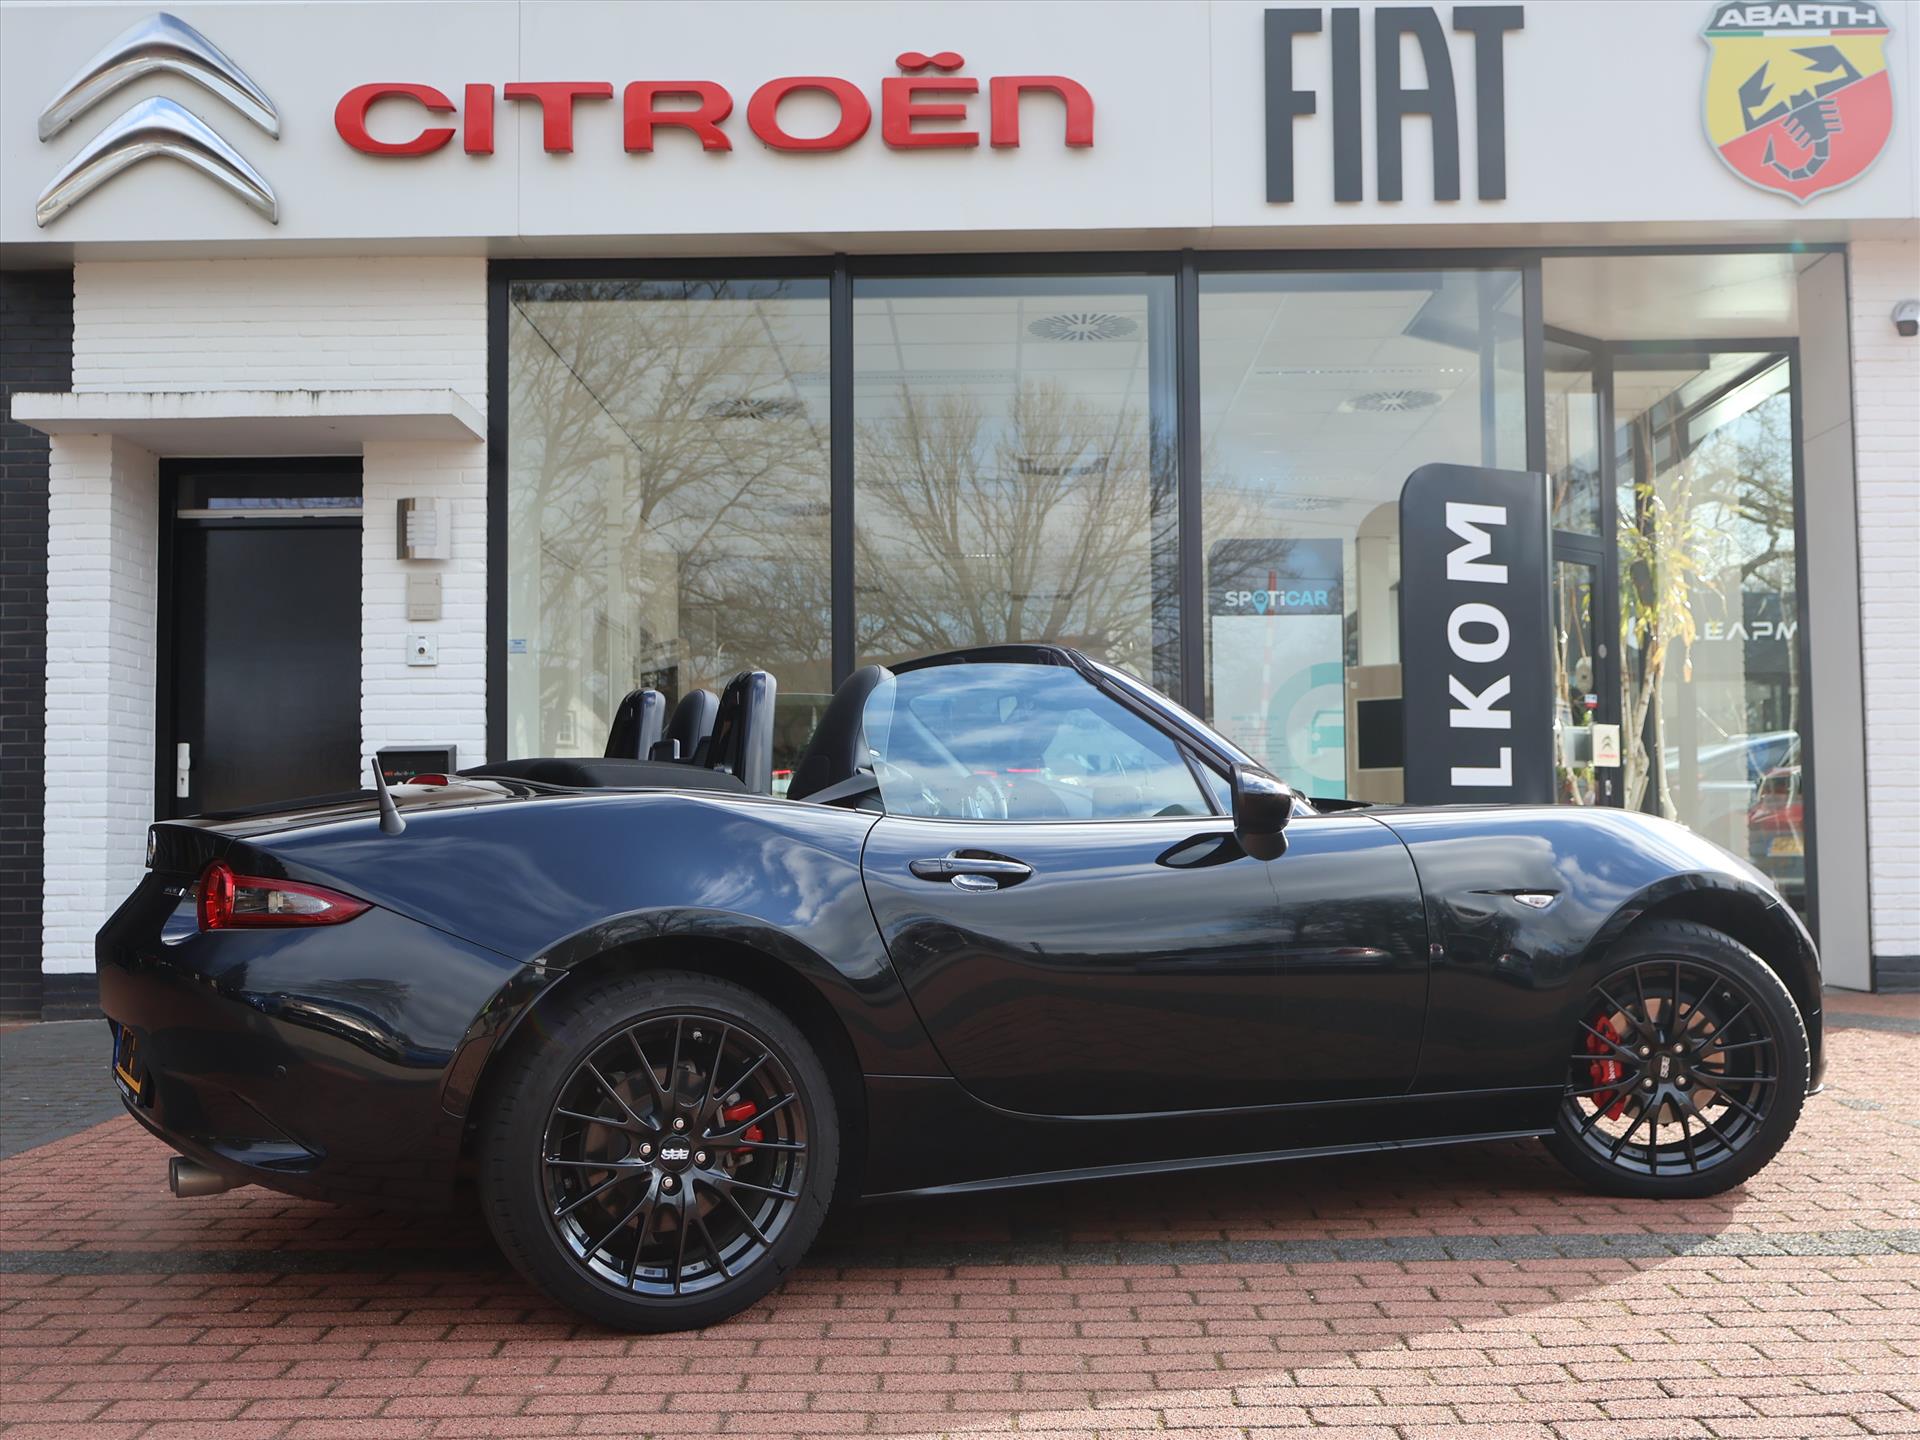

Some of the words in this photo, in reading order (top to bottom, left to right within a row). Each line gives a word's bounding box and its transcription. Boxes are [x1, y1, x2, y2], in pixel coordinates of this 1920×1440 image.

[1717, 4, 1876, 27] ABARTH
[1265, 7, 1523, 202] FIAT
[1695, 621, 1798, 641] EAPM
